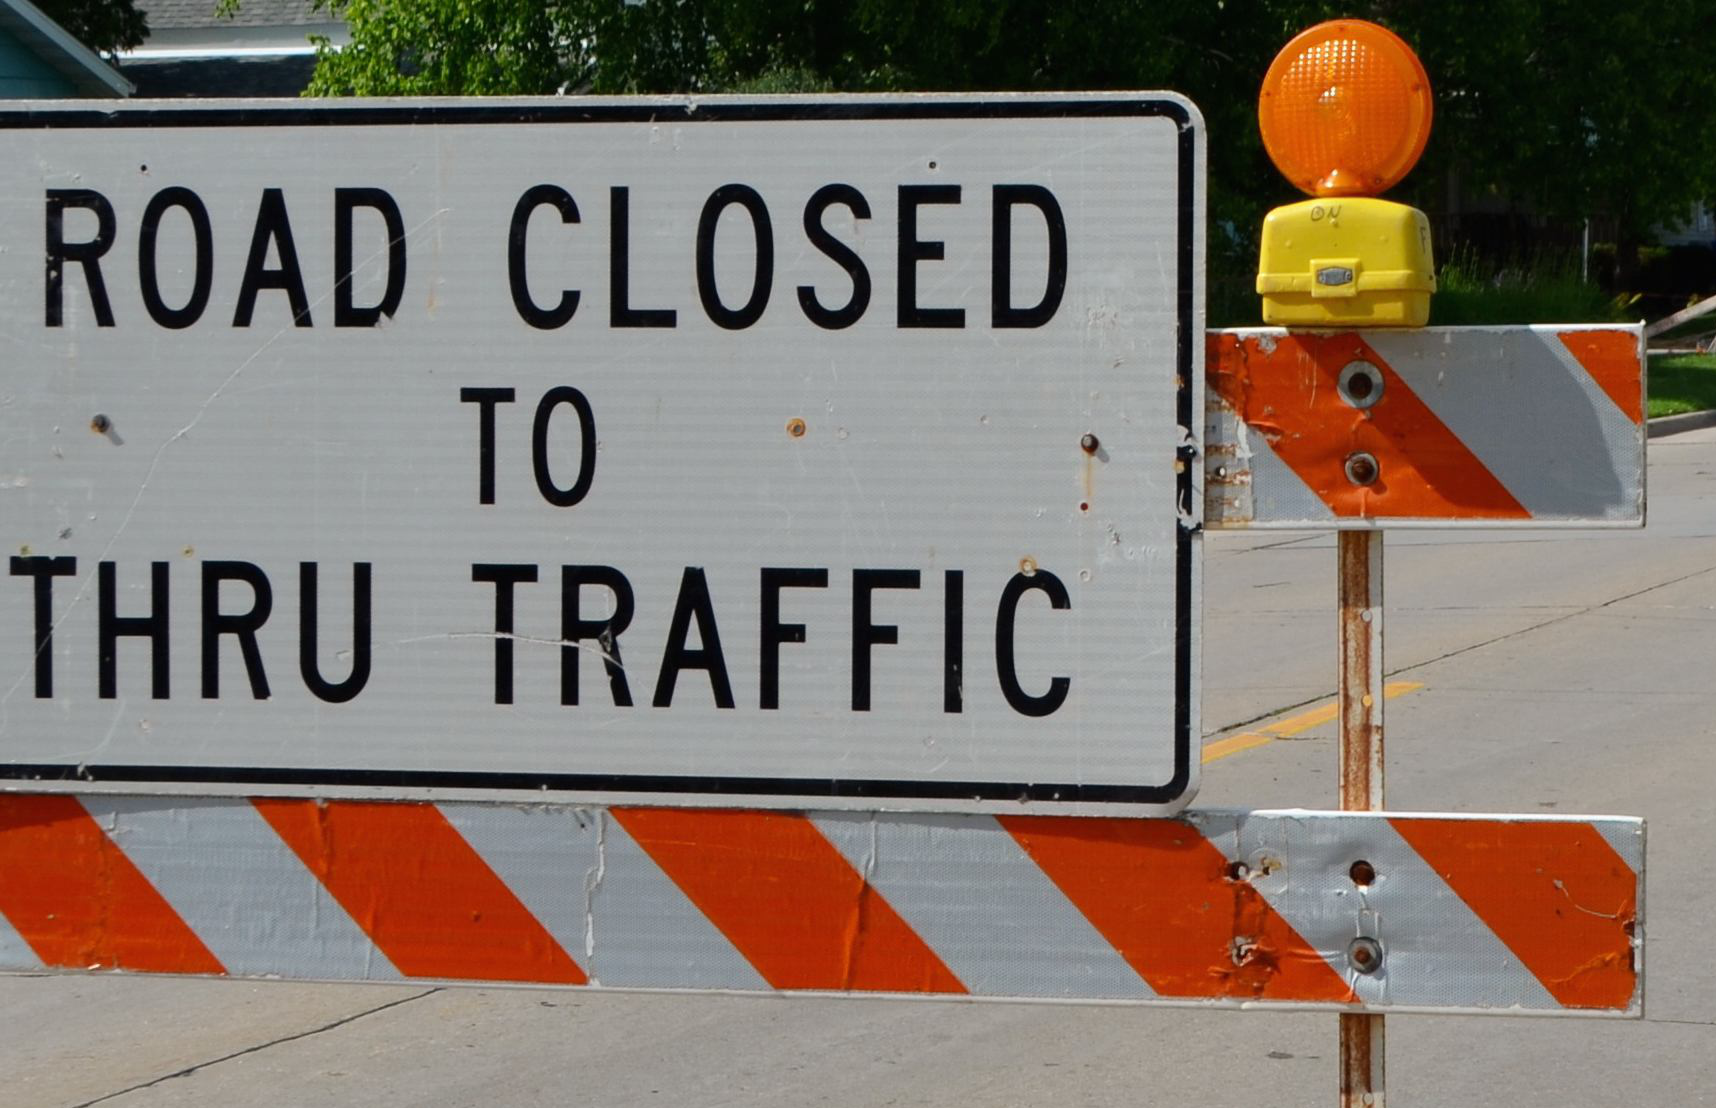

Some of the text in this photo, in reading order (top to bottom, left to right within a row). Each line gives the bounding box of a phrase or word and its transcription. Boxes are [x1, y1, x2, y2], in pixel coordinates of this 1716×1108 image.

[46, 184, 1068, 331] ROAD CLOSED
[460, 385, 597, 508] TO
[9, 555, 1072, 718] THRU TRAFFIC
